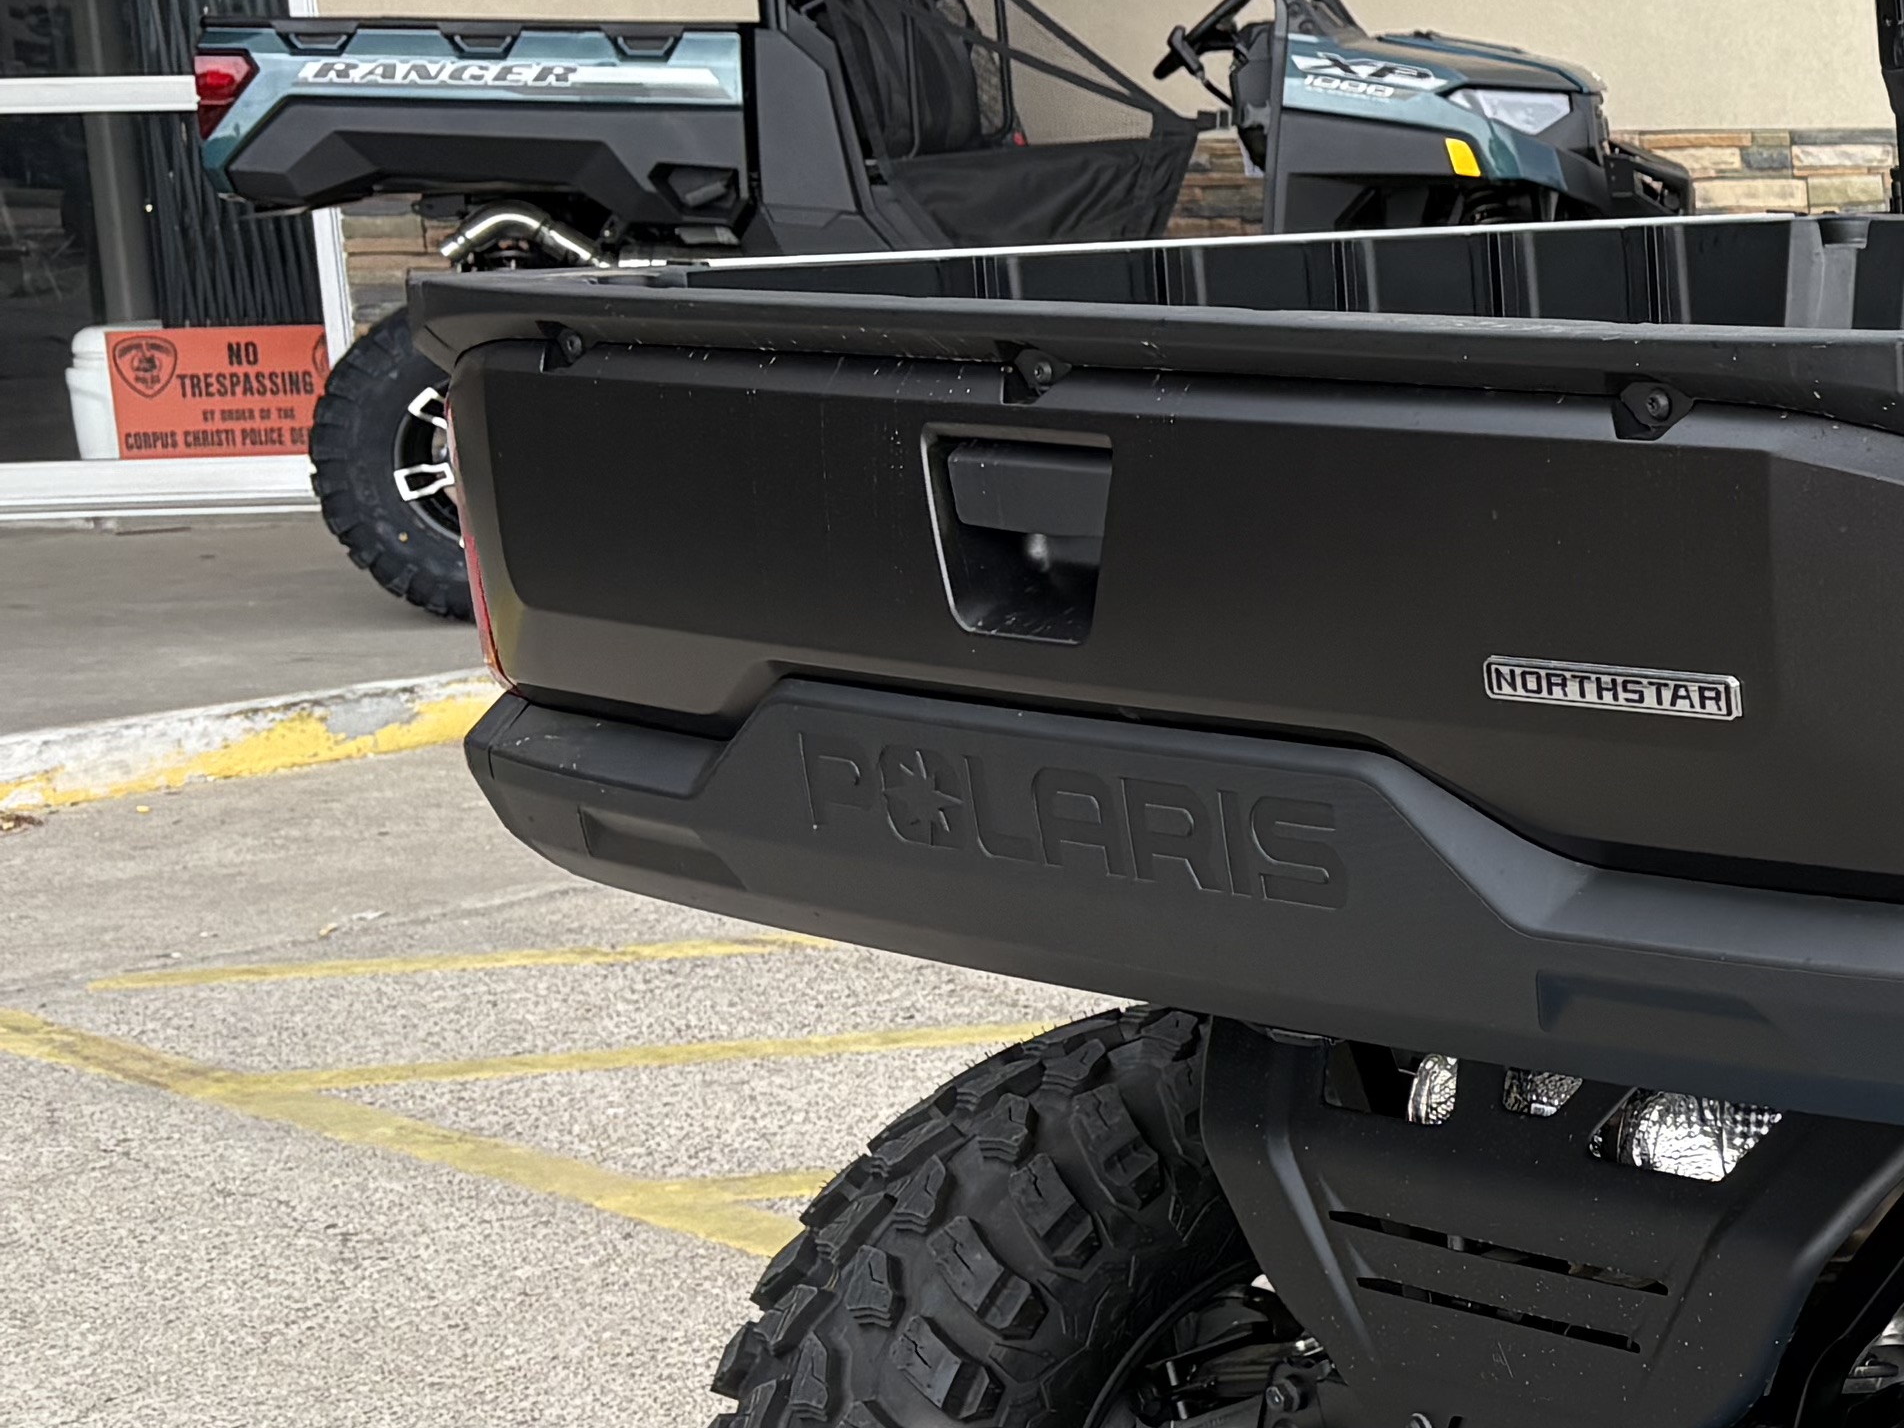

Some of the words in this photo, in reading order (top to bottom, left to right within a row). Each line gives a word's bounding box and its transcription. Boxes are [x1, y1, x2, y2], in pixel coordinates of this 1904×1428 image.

[309, 60, 579, 84] RANGER
[1304, 74, 1395, 97] 1000
[227, 341, 259, 367] NO
[176, 370, 315, 399] TRESPASSING
[125, 430, 178, 451] CORPUS
[183, 428, 236, 448] CHRISTI
[241, 426, 284, 447] POLICE
[1493, 666, 1723, 712] NORTHSTAR
[799, 732, 1348, 910] POLARIS
